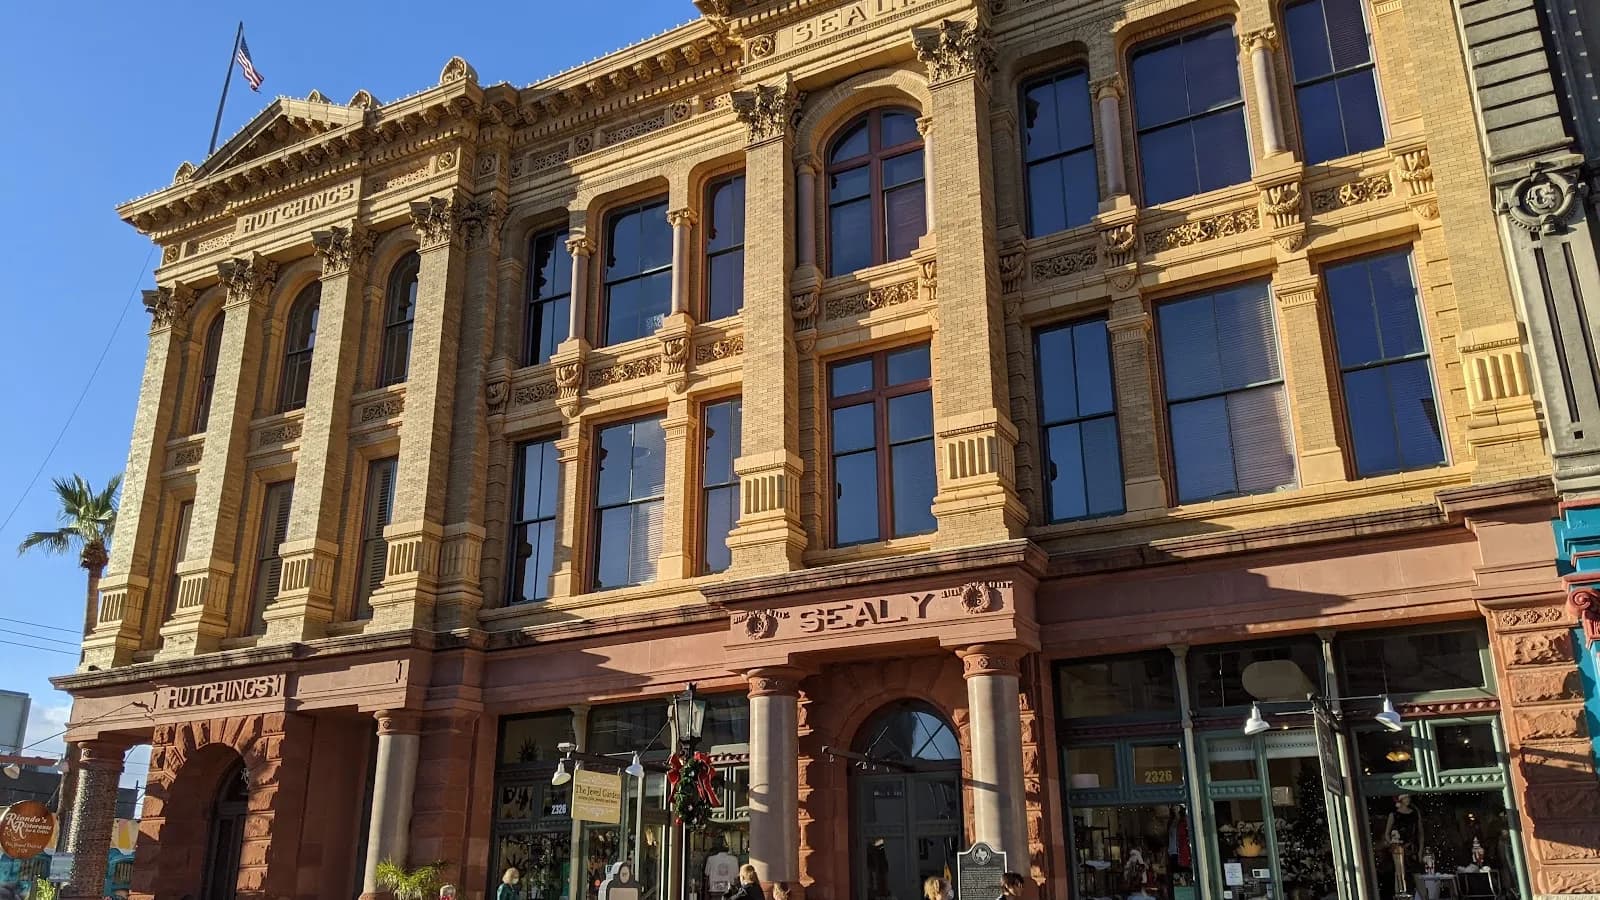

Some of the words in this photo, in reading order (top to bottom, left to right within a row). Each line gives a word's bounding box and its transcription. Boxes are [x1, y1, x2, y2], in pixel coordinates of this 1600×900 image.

[795, 0, 916, 46] SEAL
[242, 183, 354, 233] HUTCHINGS
[800, 594, 935, 632] SEALY
[168, 678, 274, 709] HUTCHINGS
[576, 784, 587, 794] The
[587, 786, 602, 797] Jewel
[1144, 770, 1173, 784] 2326
[6, 812, 48, 829] Riondo's
